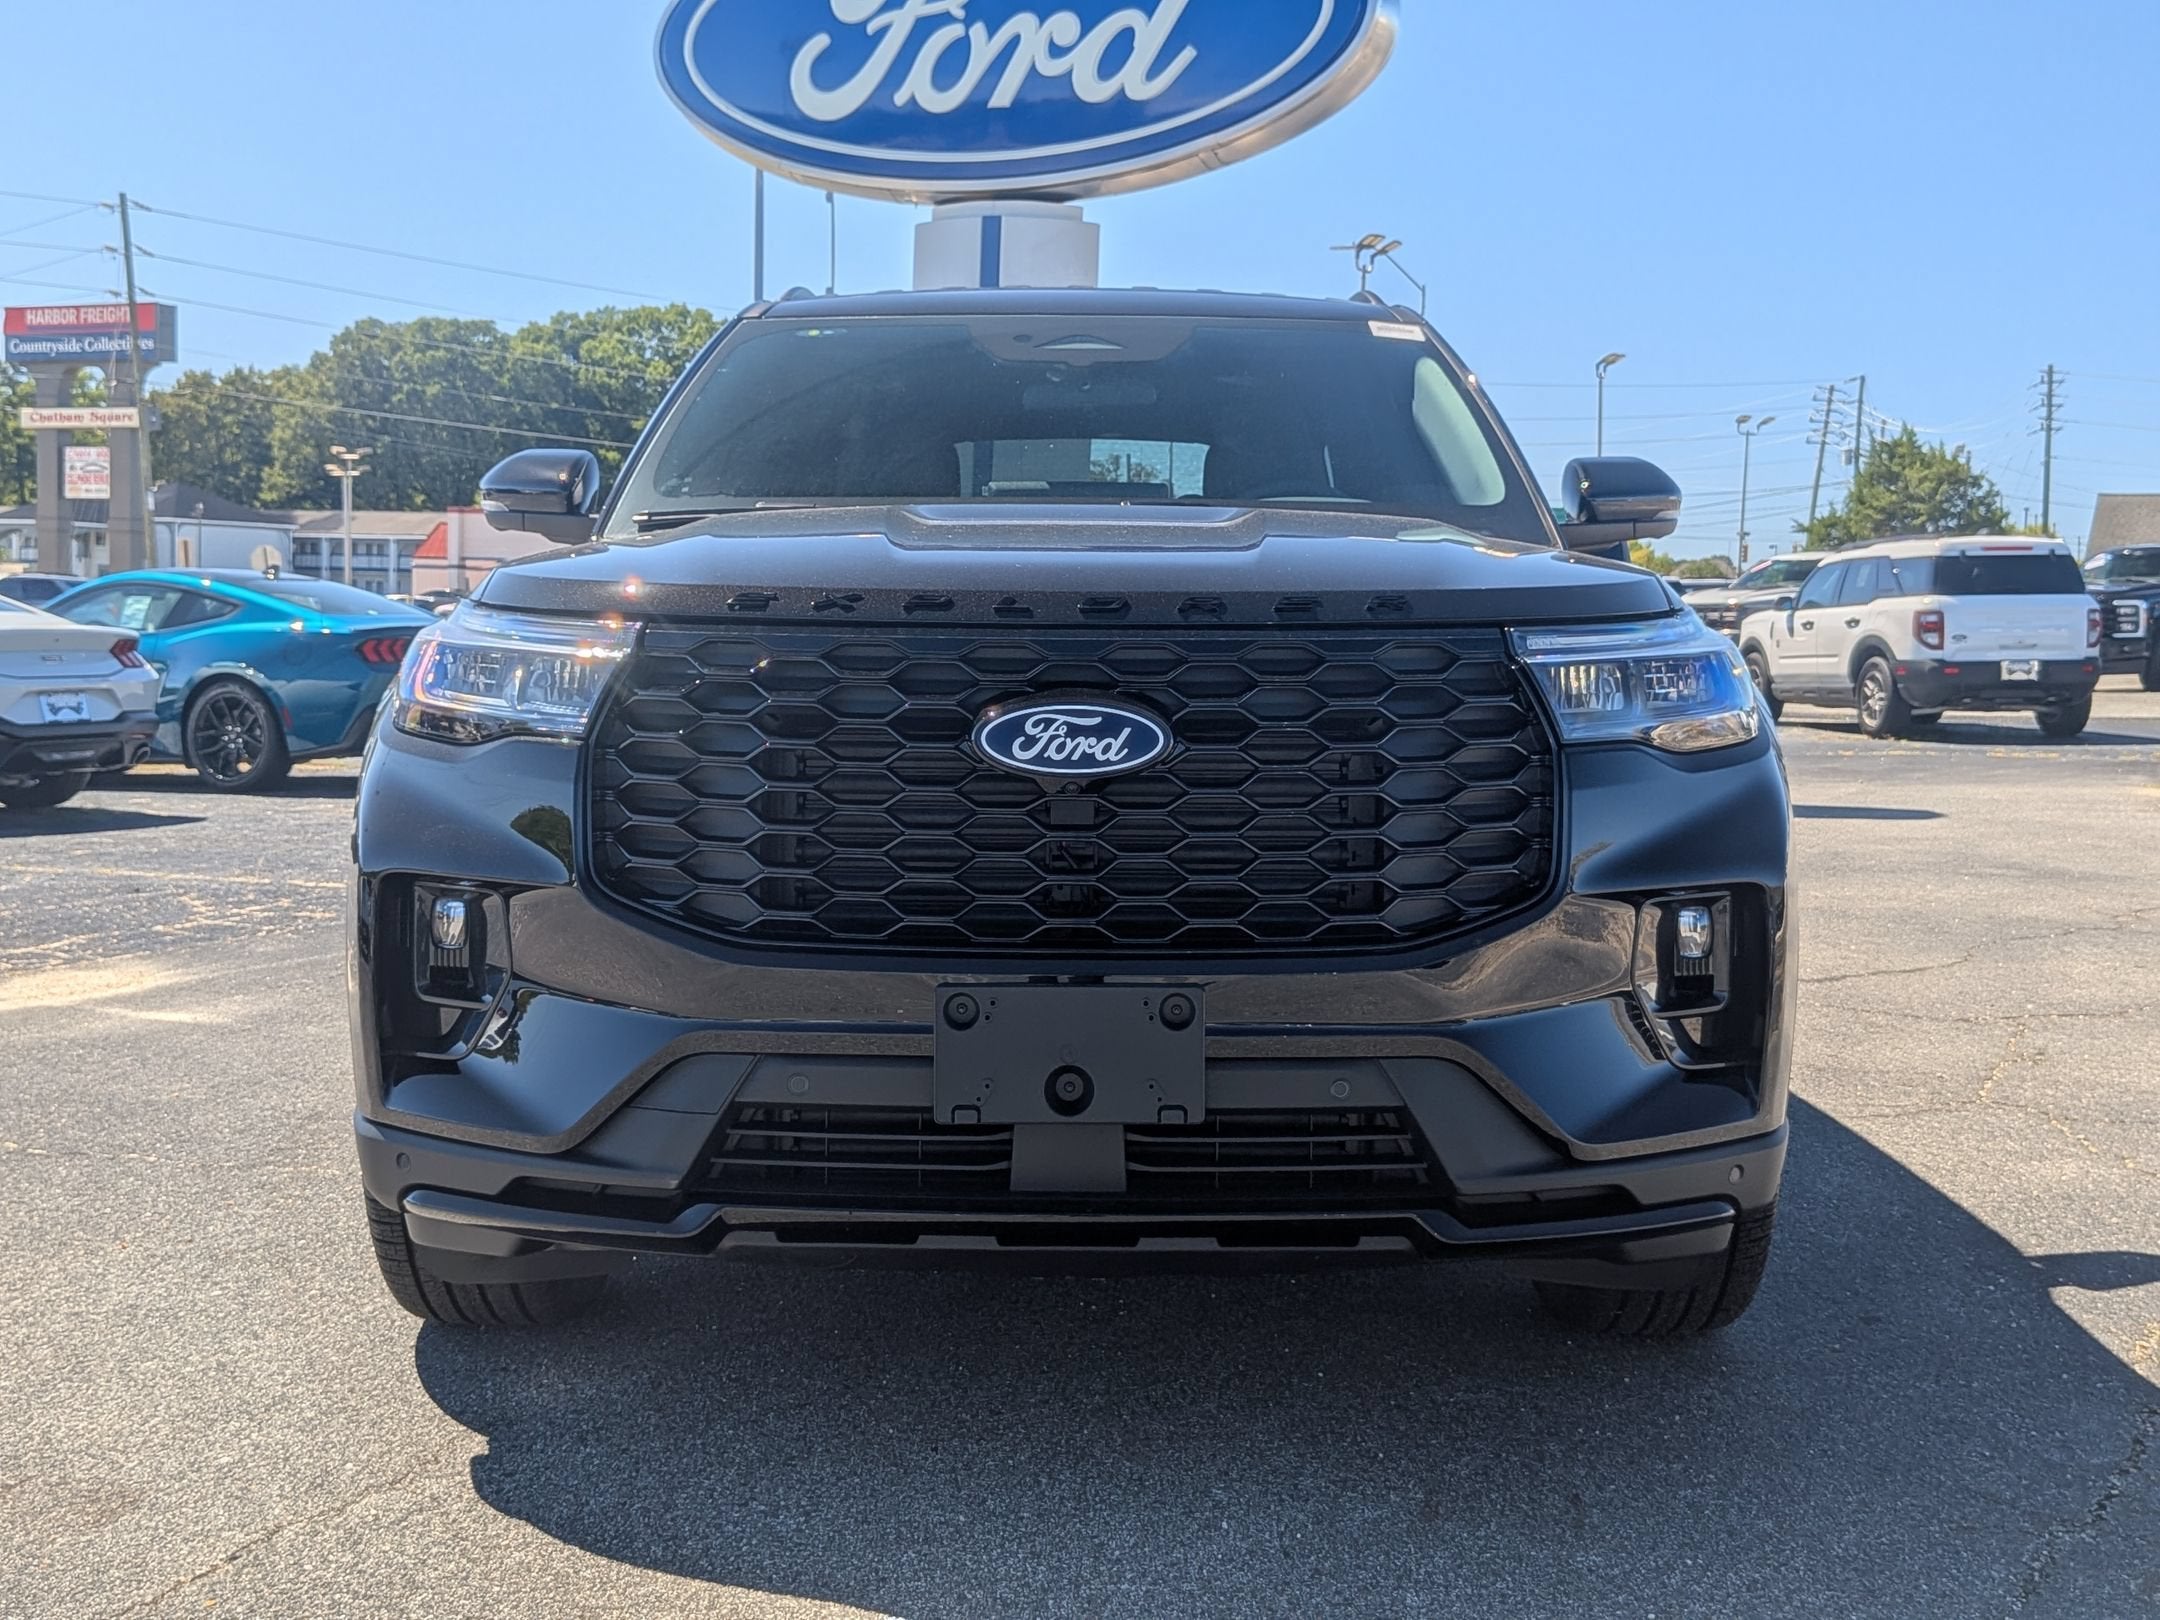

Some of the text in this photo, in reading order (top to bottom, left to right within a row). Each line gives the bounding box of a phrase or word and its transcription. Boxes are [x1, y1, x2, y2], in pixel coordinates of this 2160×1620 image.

[789, 0, 1197, 122] Ford
[26, 305, 131, 326] HARBOR FREIGHT
[10, 334, 155, 357] Countryside Collecties
[29, 409, 134, 426] Chatham Square
[1012, 713, 1132, 761] Ford
